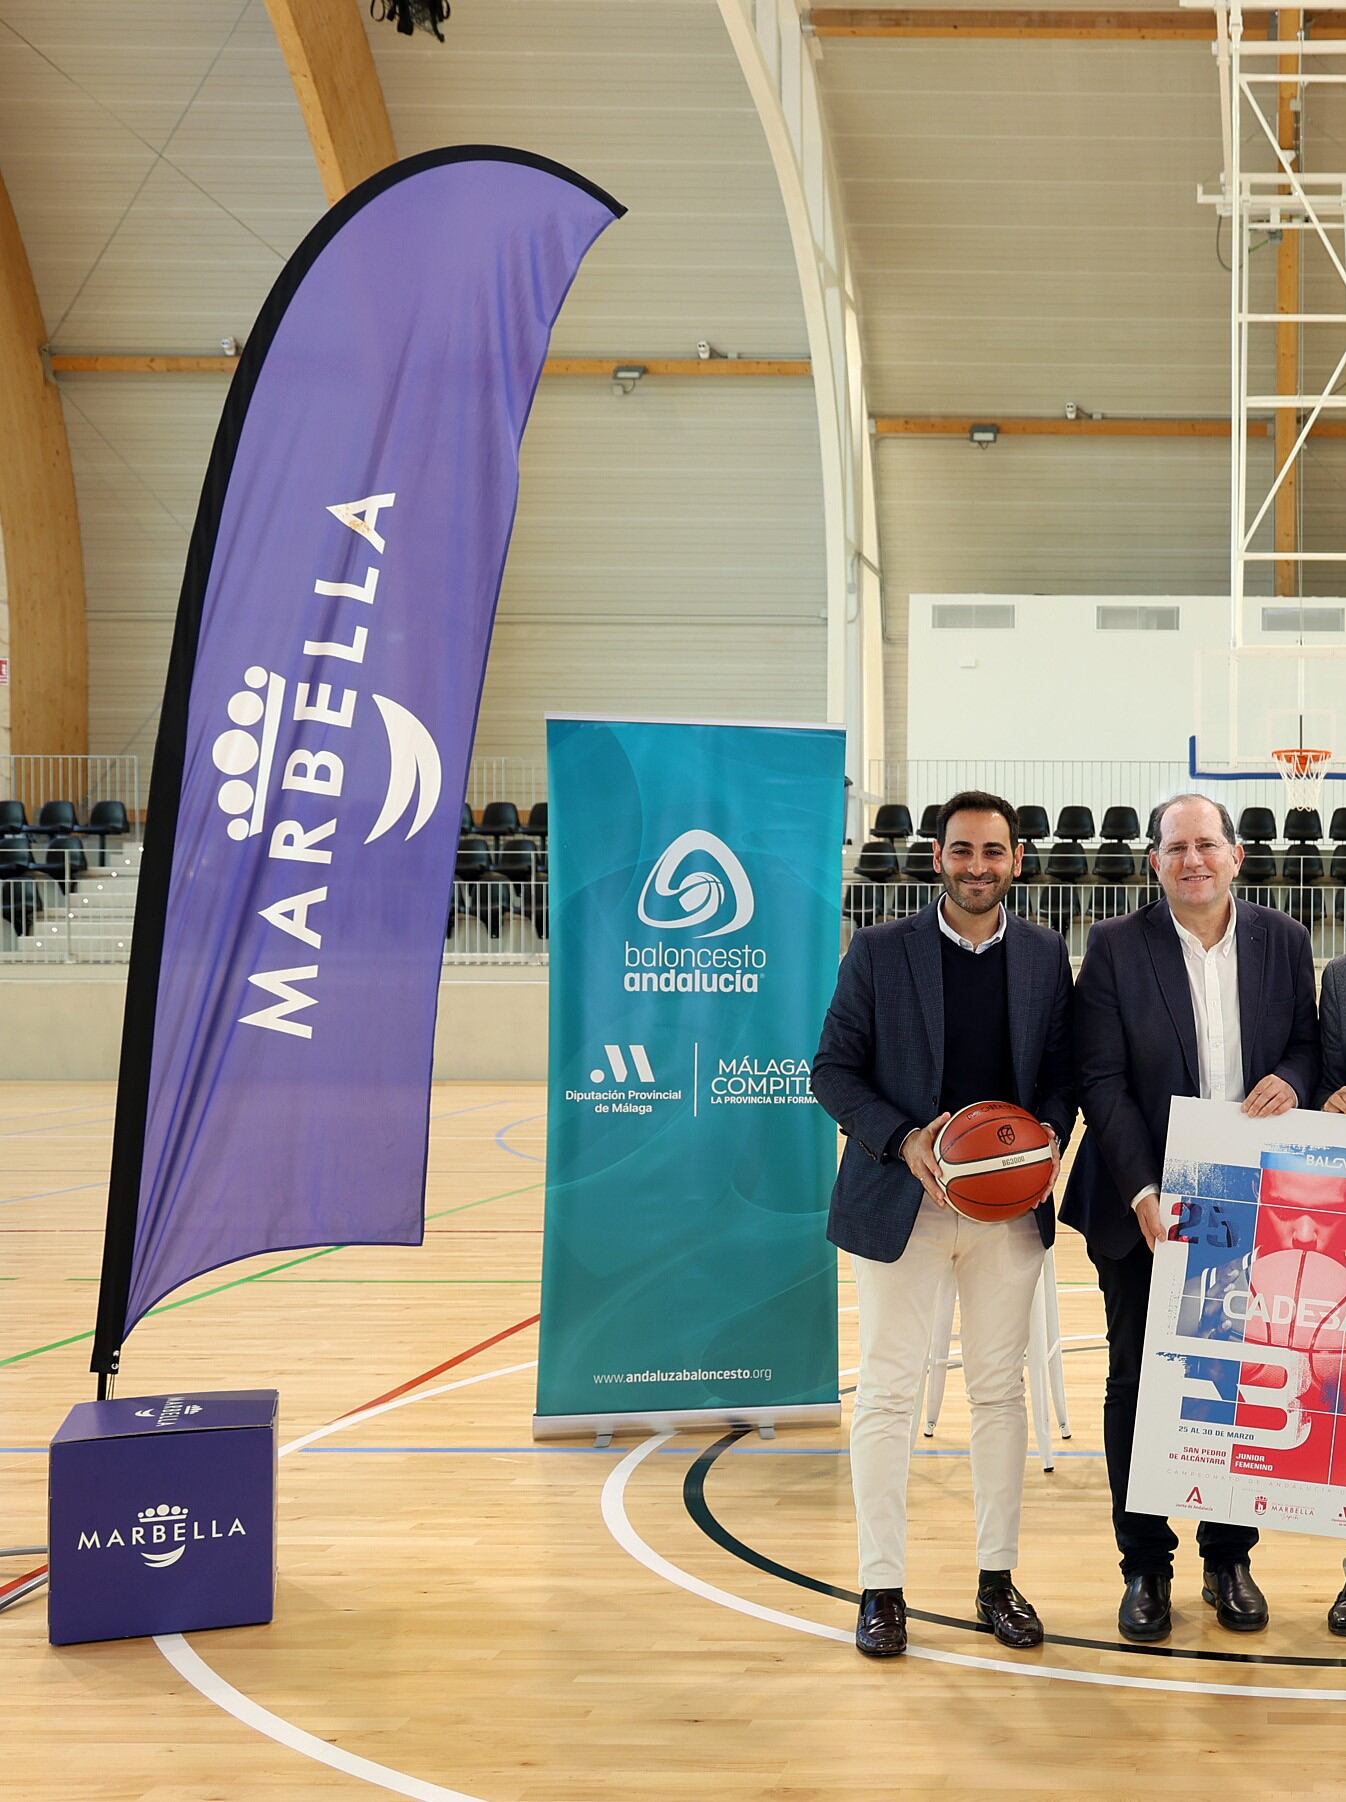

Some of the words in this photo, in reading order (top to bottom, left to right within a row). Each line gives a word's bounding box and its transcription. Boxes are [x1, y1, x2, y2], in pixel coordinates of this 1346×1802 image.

[236, 492, 396, 1039] MARBELLA
[625, 941, 767, 968] baloncesto
[623, 969, 758, 993] andalucía
[718, 1055, 811, 1075] MÁLAGA
[565, 1089, 625, 1102] Diputación
[628, 1089, 682, 1100] Provincial
[711, 1096, 722, 1104] LA
[724, 1096, 772, 1104] PROVINCIA
[774, 1096, 786, 1104] EN
[787, 1096, 819, 1104] FORMA
[594, 1103, 610, 1113] de
[612, 1103, 653, 1115] Málaga
[593, 1367, 772, 1384] www.andaluzabaloncesto.org
[1178, 1425, 1189, 1433] 25
[1190, 1426, 1201, 1434] AL
[1202, 1428, 1213, 1436] 30
[1226, 1431, 1255, 1441] MARZO
[1183, 1446, 1200, 1454] SAN
[1201, 1448, 1227, 1457] PEDRO
[1235, 1453, 1265, 1462] JUNIOR
[1168, 1452, 1178, 1460] DE
[1180, 1453, 1226, 1465] ALCÁNTARA
[1234, 1461, 1274, 1472] FEMENINO
[1271, 1504, 1314, 1516] MARBELLA
[77, 1517, 246, 1551] MARBELLA
